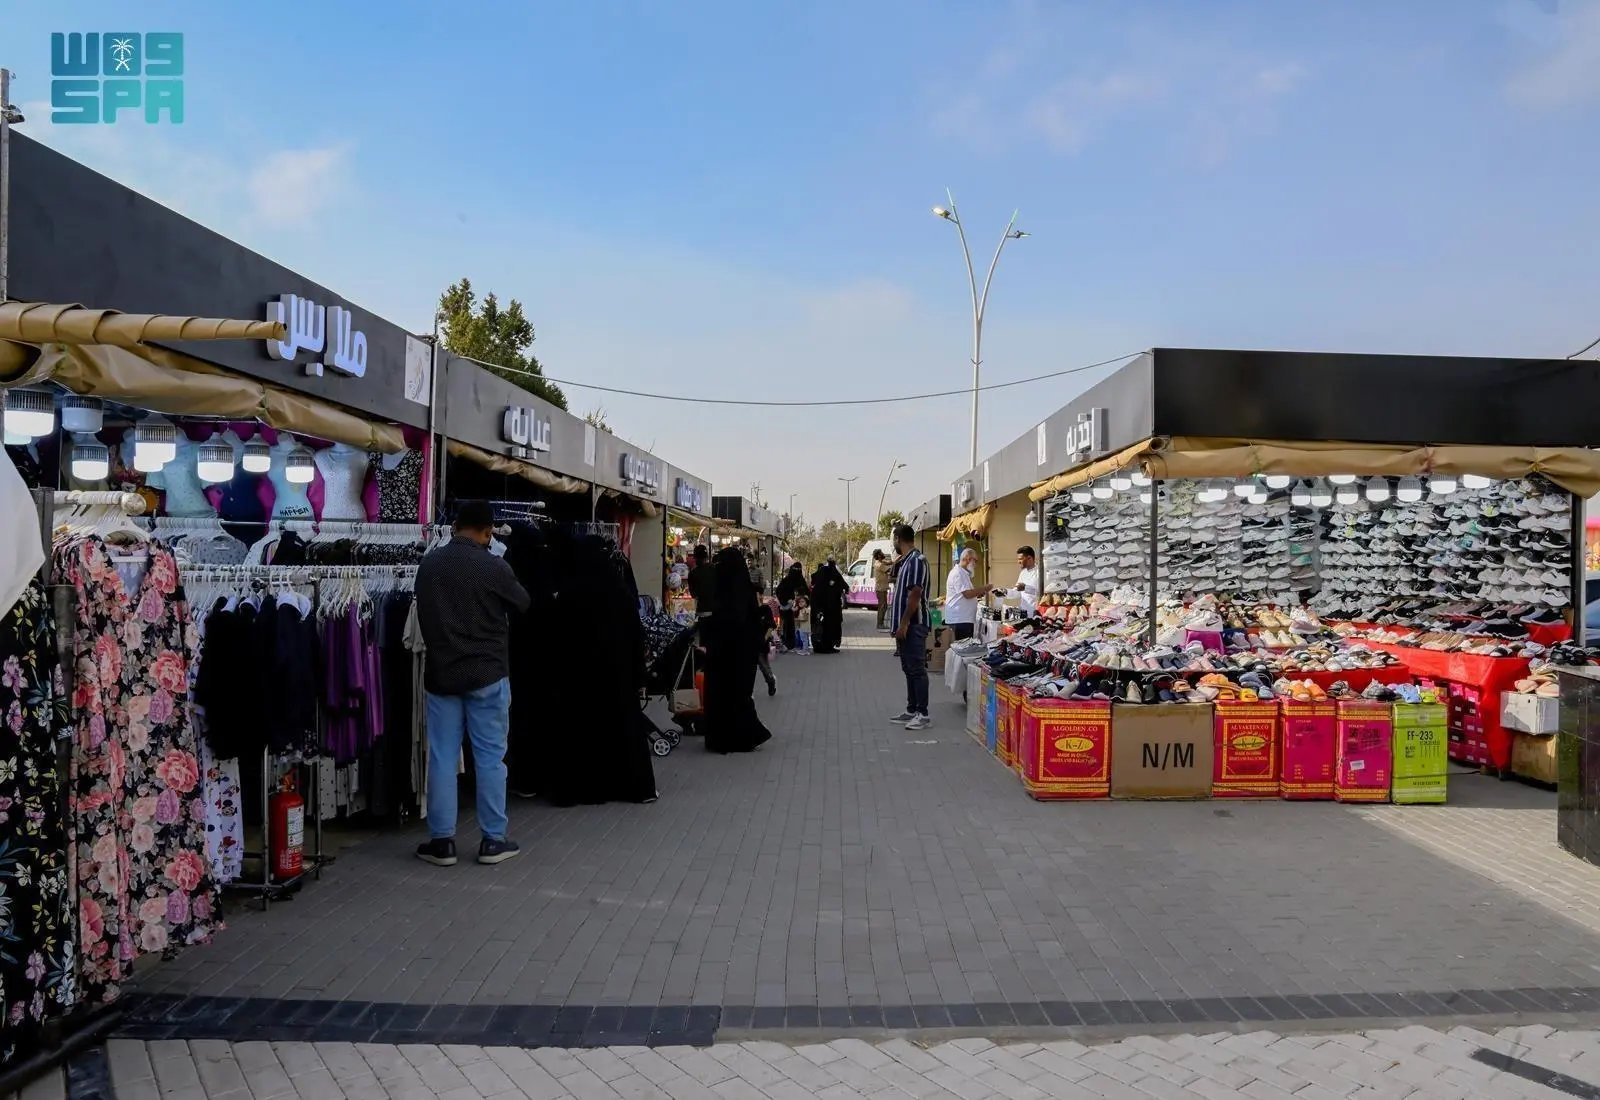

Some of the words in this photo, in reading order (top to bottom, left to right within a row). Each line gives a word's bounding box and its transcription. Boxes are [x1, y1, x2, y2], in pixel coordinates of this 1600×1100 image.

[266, 293, 368, 378] ملابس
[1407, 730, 1434, 741] FF-233
[1142, 742, 1195, 771] N/M
